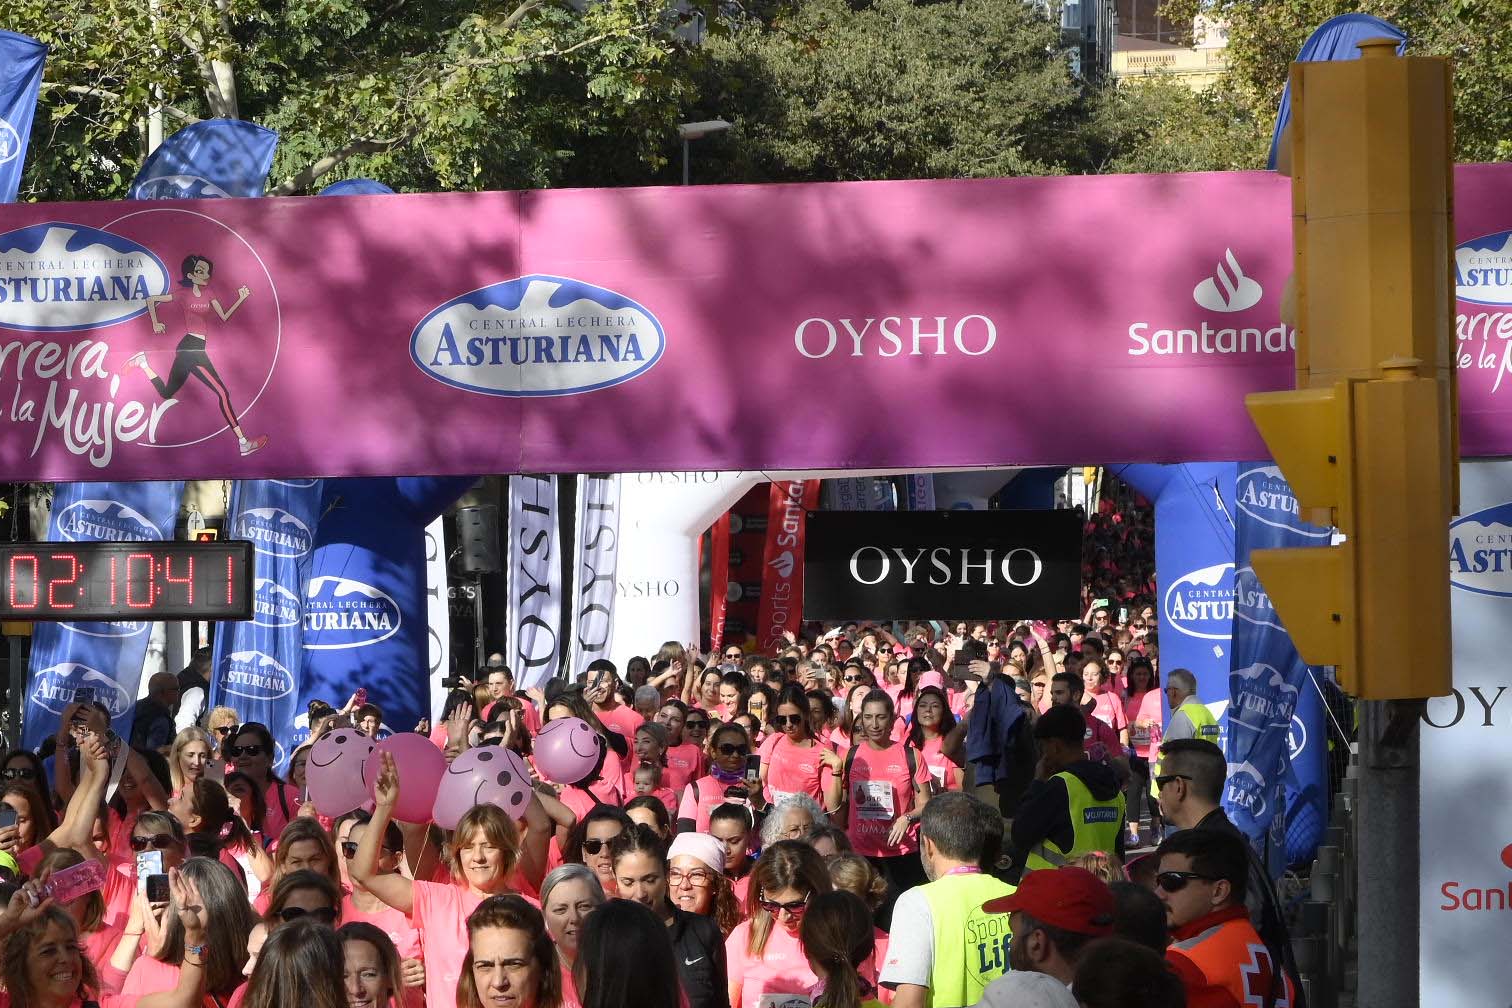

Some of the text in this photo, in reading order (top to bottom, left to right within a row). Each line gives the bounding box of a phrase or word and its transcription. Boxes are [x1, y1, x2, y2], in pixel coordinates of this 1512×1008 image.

[72, 258, 144, 270] LECHERA
[469, 315, 637, 331] CENTRAL LECHERA
[794, 314, 997, 359] OYSHO
[1128, 322, 1295, 356] Santand
[430, 322, 645, 368] ASTURIANA
[11, 382, 35, 423] la
[31, 374, 178, 468] Mujer
[849, 546, 1043, 587] OYSHO
[338, 600, 388, 609] LECHERA
[978, 933, 1012, 975] Lif
